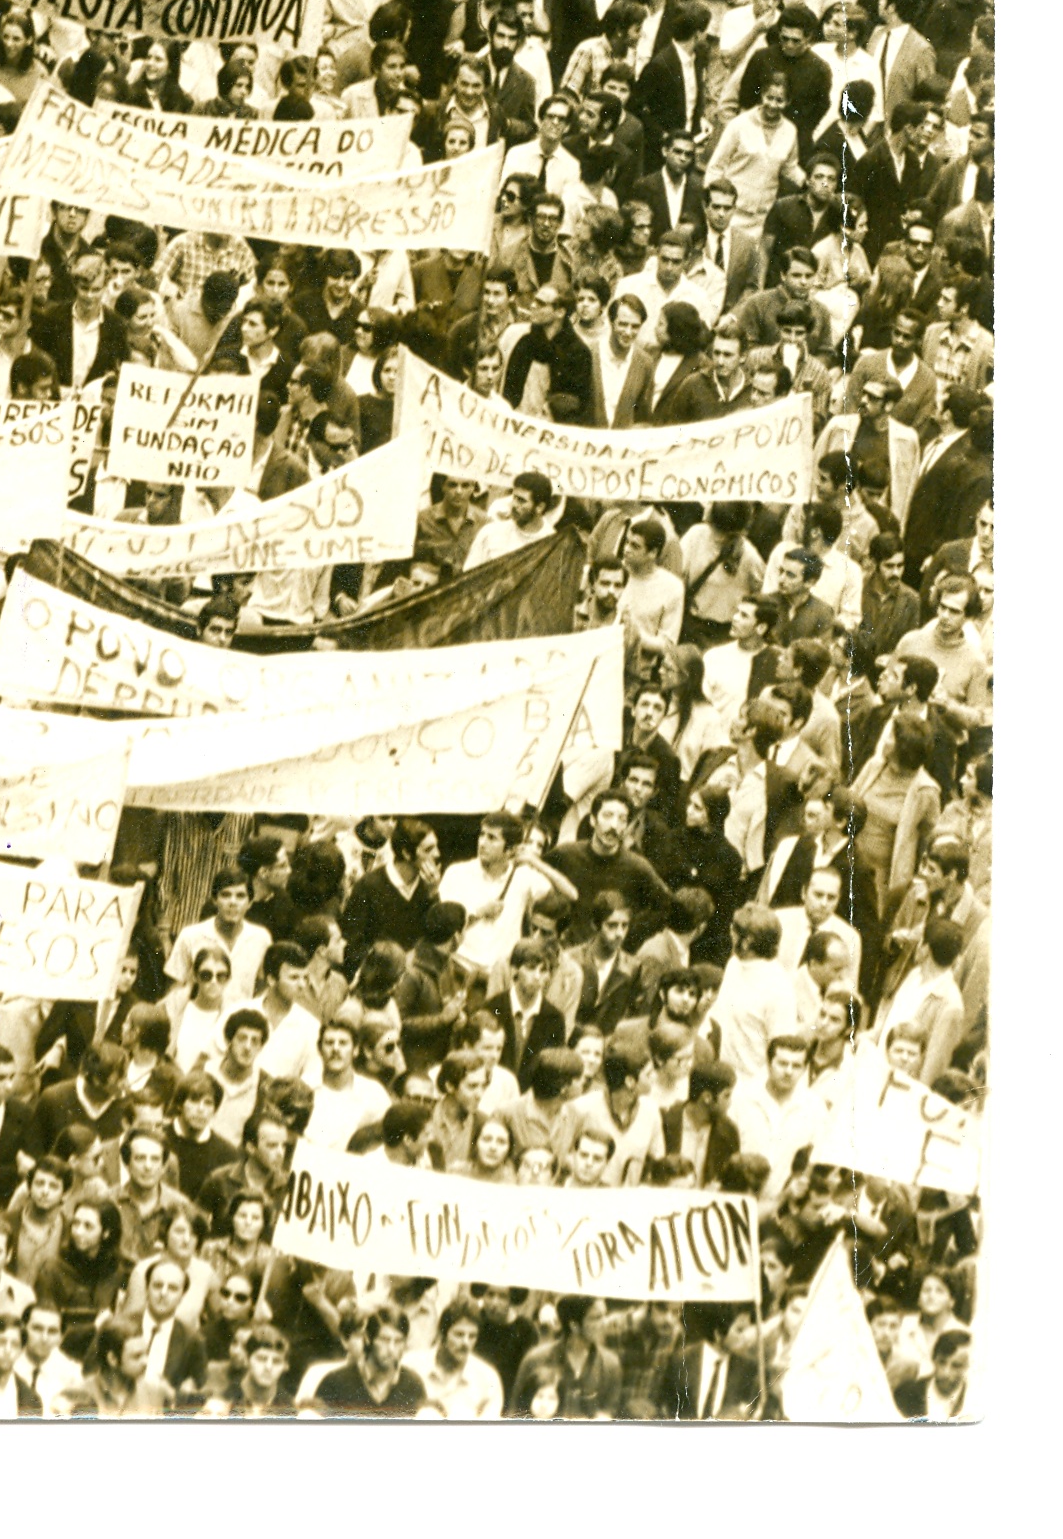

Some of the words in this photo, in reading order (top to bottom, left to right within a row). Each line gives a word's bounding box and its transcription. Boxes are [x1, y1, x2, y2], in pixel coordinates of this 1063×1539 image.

[204, 119, 322, 158] MÉDICA
[336, 127, 375, 155] DO
[419, 374, 445, 409] A
[458, 391, 642, 460] UNIVERSIDA
[735, 416, 804, 451] POVO
[484, 444, 515, 475] DE
[22, 597, 52, 633] O
[63, 608, 189, 689] POVO
[22, 881, 124, 929] PARA
[282, 1170, 373, 1247] ABAIXO
